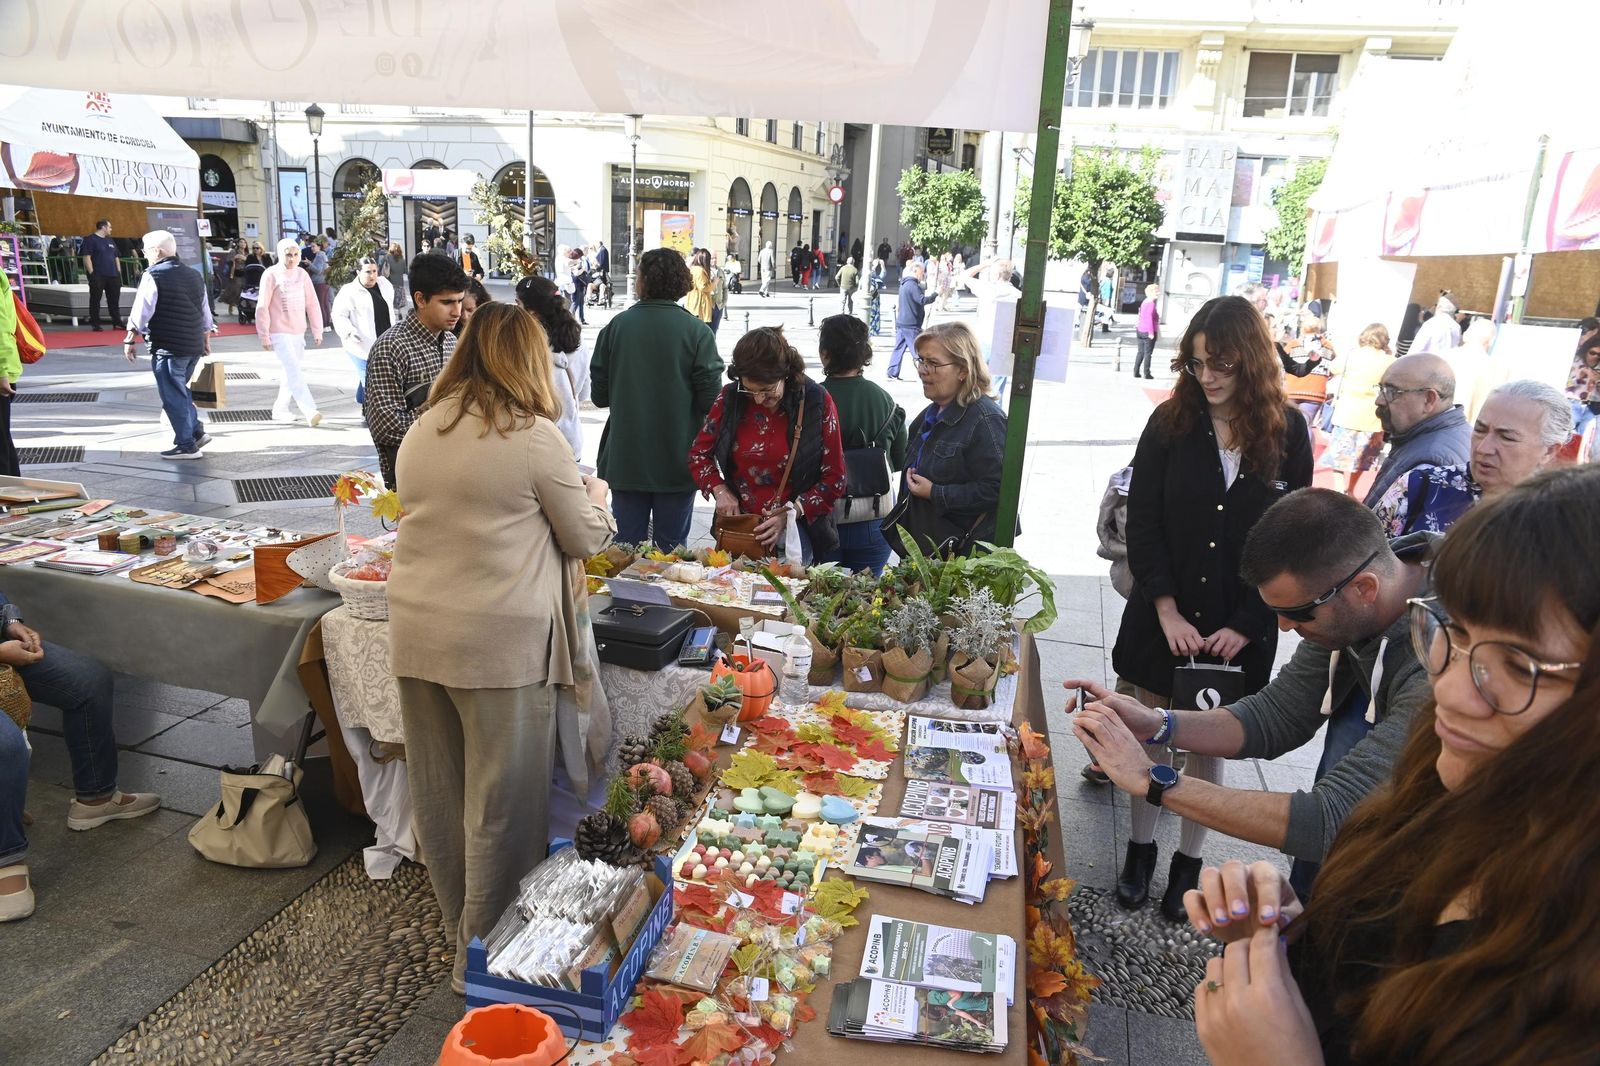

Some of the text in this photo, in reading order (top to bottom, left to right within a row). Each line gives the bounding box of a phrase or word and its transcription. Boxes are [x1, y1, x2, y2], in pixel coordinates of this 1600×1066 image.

[41, 122, 106, 141] AYUNTAMIENTO
[108, 133, 118, 143] DE
[620, 177, 651, 185] ALARO
[663, 180, 695, 188] MORENO
[1181, 205, 1226, 227] CIA
[901, 779, 930, 818] ACOPINB
[935, 846, 957, 880] ACOPINB
[611, 892, 670, 1021] ACOPINB
[679, 942, 698, 975] ACOPINB
[868, 933, 882, 965] ACOPINB
[889, 922, 904, 978] PROGRAMA FORMATIVO
[883, 984, 892, 1012] ACOPINB
